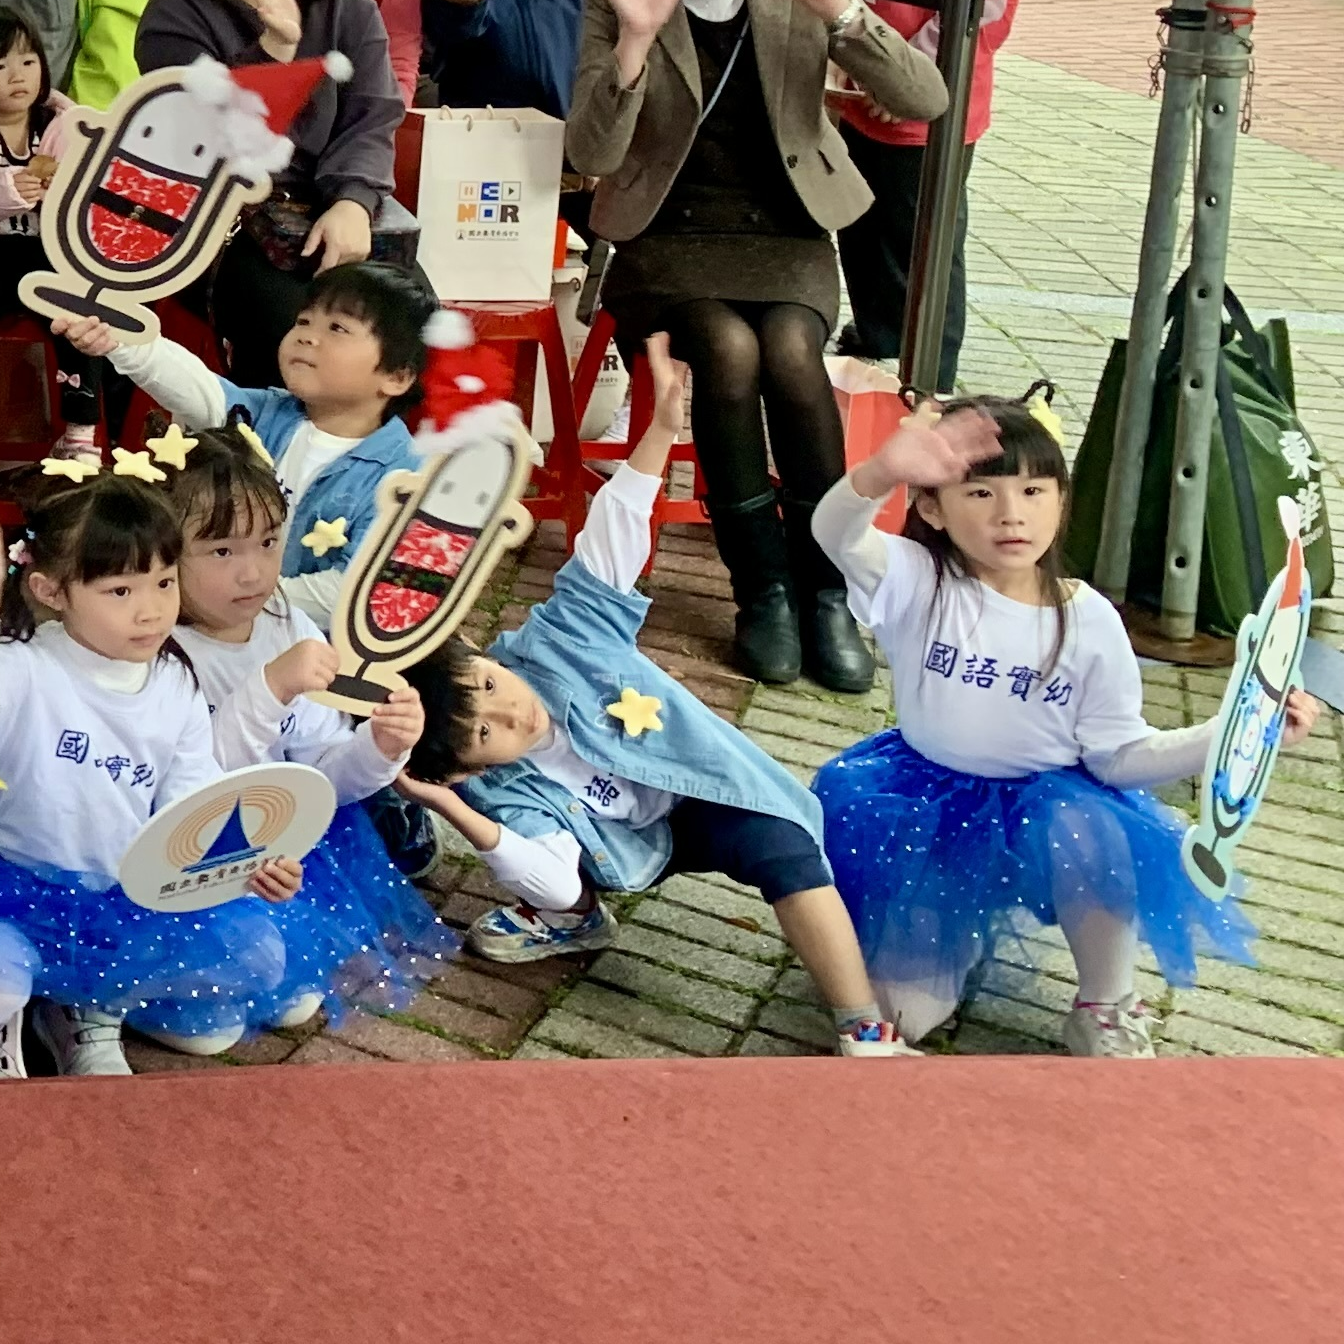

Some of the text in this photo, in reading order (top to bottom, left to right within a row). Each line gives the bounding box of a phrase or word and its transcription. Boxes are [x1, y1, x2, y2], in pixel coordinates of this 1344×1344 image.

[925, 640, 1073, 706] 國語實幼
[55, 729, 155, 787] 國實幼
